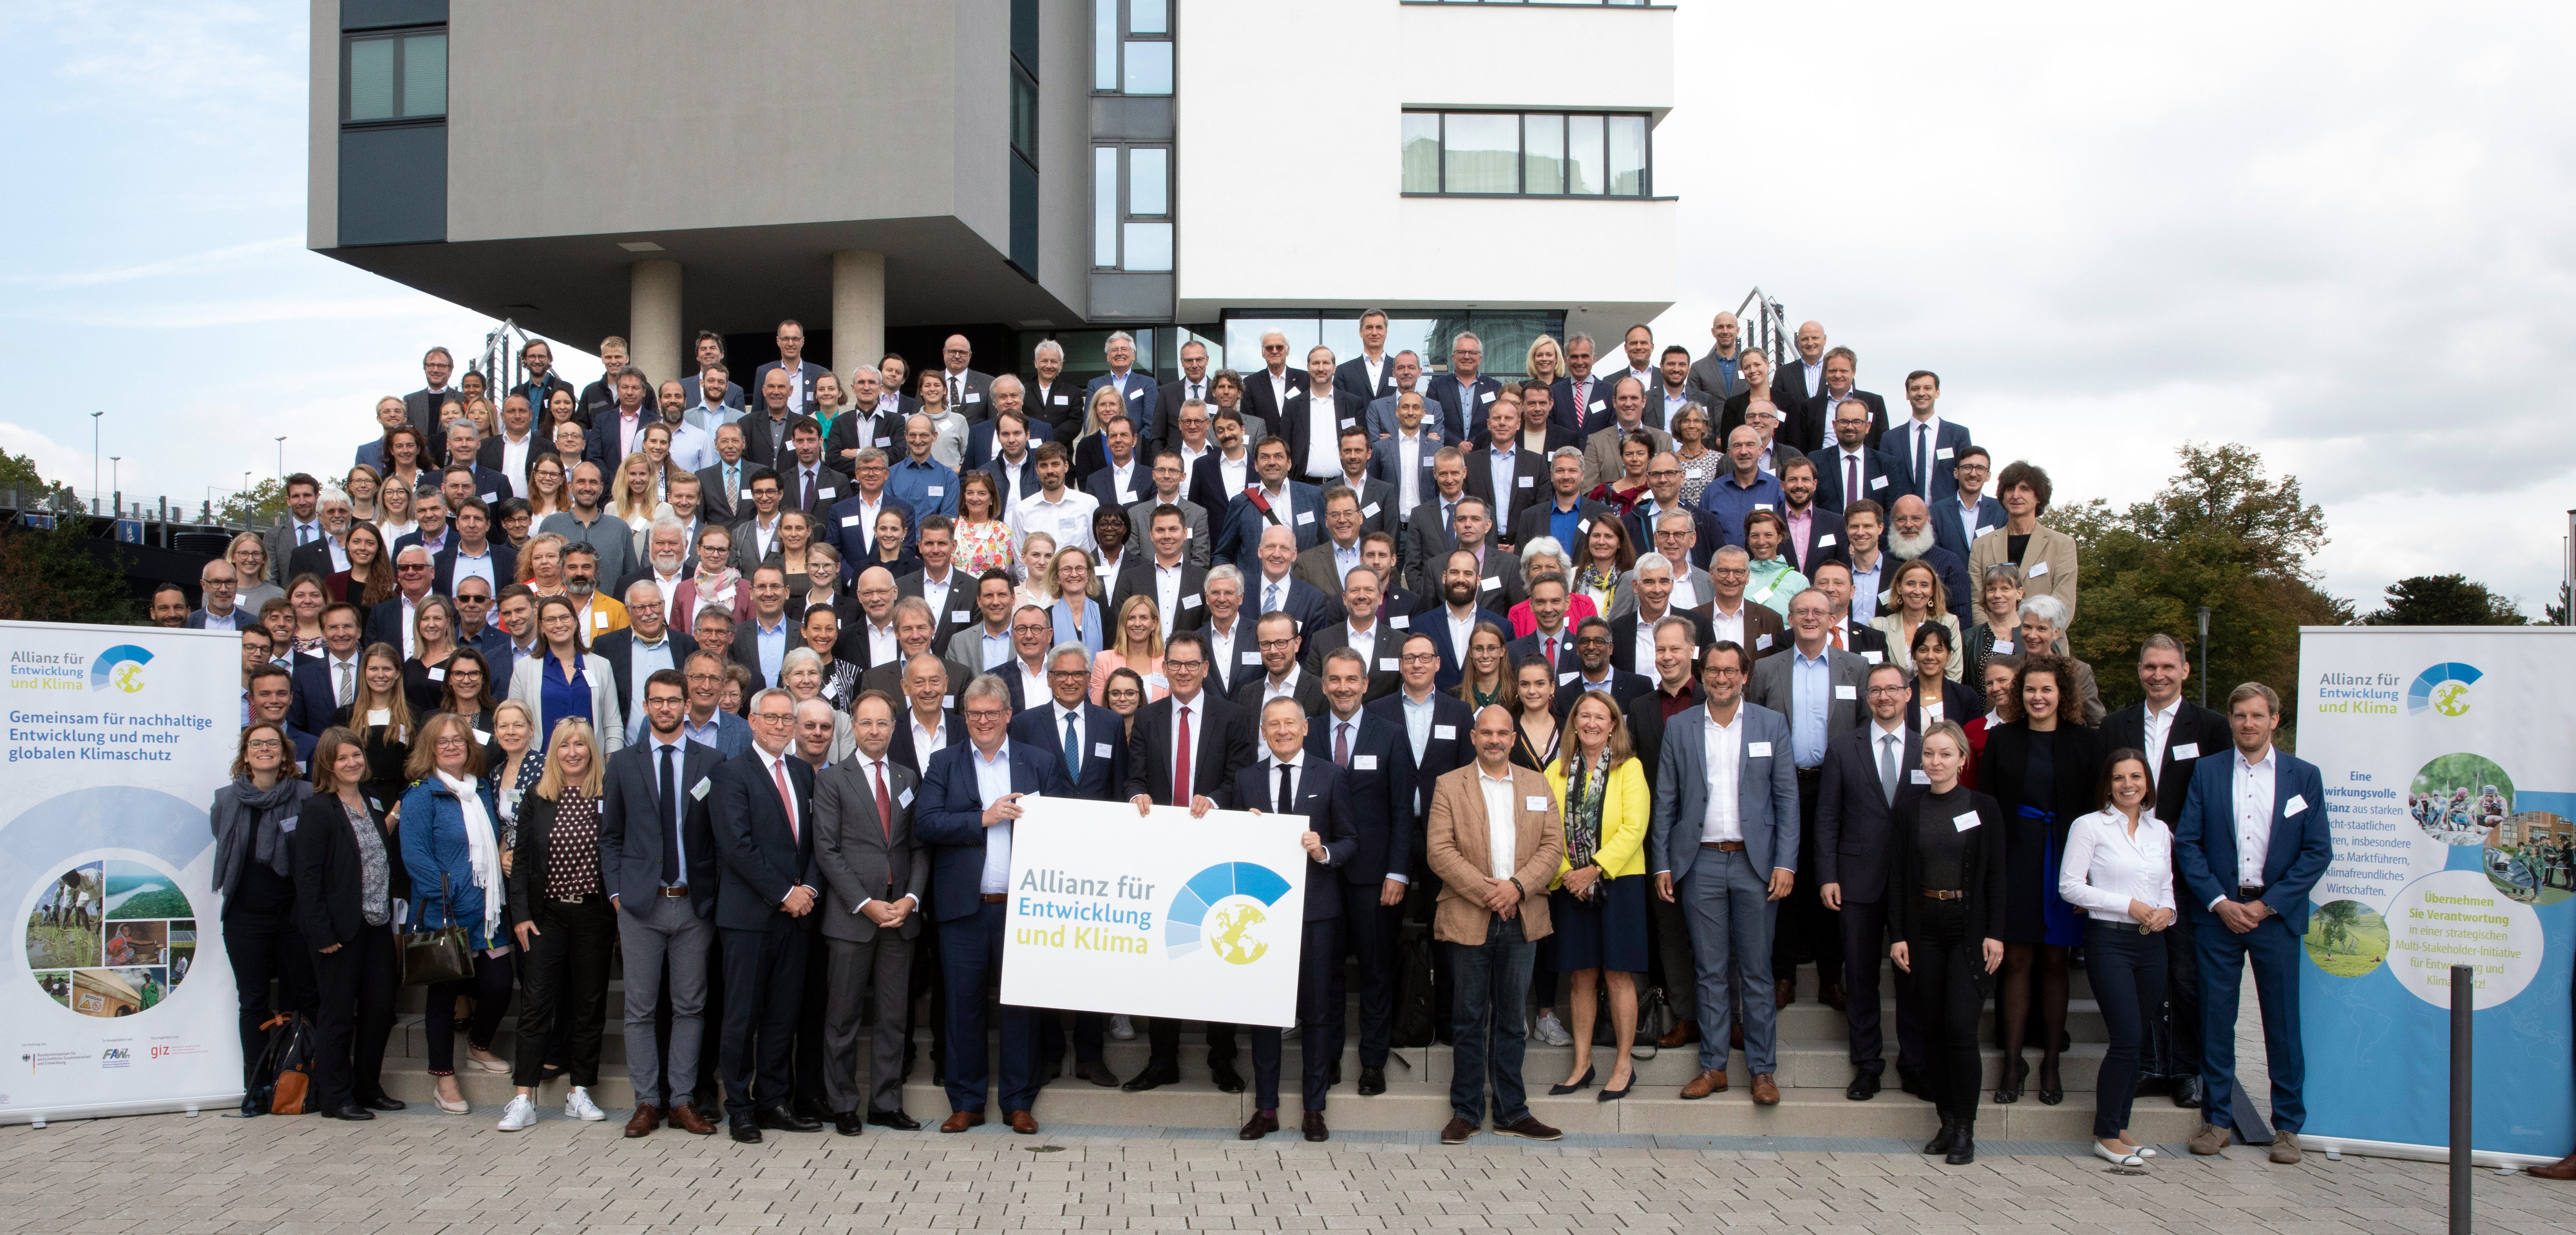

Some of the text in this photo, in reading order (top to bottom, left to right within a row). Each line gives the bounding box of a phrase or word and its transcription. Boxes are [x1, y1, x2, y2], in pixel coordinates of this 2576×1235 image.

[11, 651, 84, 664] Allianz für
[11, 665, 83, 678] Entwicklung
[11, 678, 82, 690] und Klima
[2320, 673, 2400, 686] Allianz für
[2320, 688, 2399, 702] Entwicklung
[2319, 701, 2397, 714] und Klima
[10, 711, 212, 730] Gemeinsam für nachhaltige
[10, 729, 180, 745] Entwicklung und mehr
[9, 746, 171, 761] globalen Klimaschutz
[2350, 771, 2371, 781] Eine
[2325, 787, 2396, 799] wirkungsvolle
[2326, 802, 2403, 815] lianz aus starken
[2329, 818, 2395, 831] icht-staatlichen
[2352, 836, 2410, 848] insbesondere
[2347, 852, 2410, 866] Marktführern,
[2325, 867, 2404, 881] klimafreundliches
[1019, 868, 1155, 900] Allianz für
[2327, 883, 2386, 896] Wirtschaften.
[2425, 891, 2494, 906] Übernehmen
[1019, 897, 1151, 930] Entwicklung
[2409, 908, 2509, 926] Sie Verantwortung
[1017, 925, 1148, 954] und Klima
[2409, 924, 2508, 941] in einer strategischen
[2396, 940, 2521, 959] Multi-Stakeholder-Initiative
[2410, 957, 2423, 968] für
[2486, 963, 2504, 974] und
[151, 1044, 169, 1059] giz
